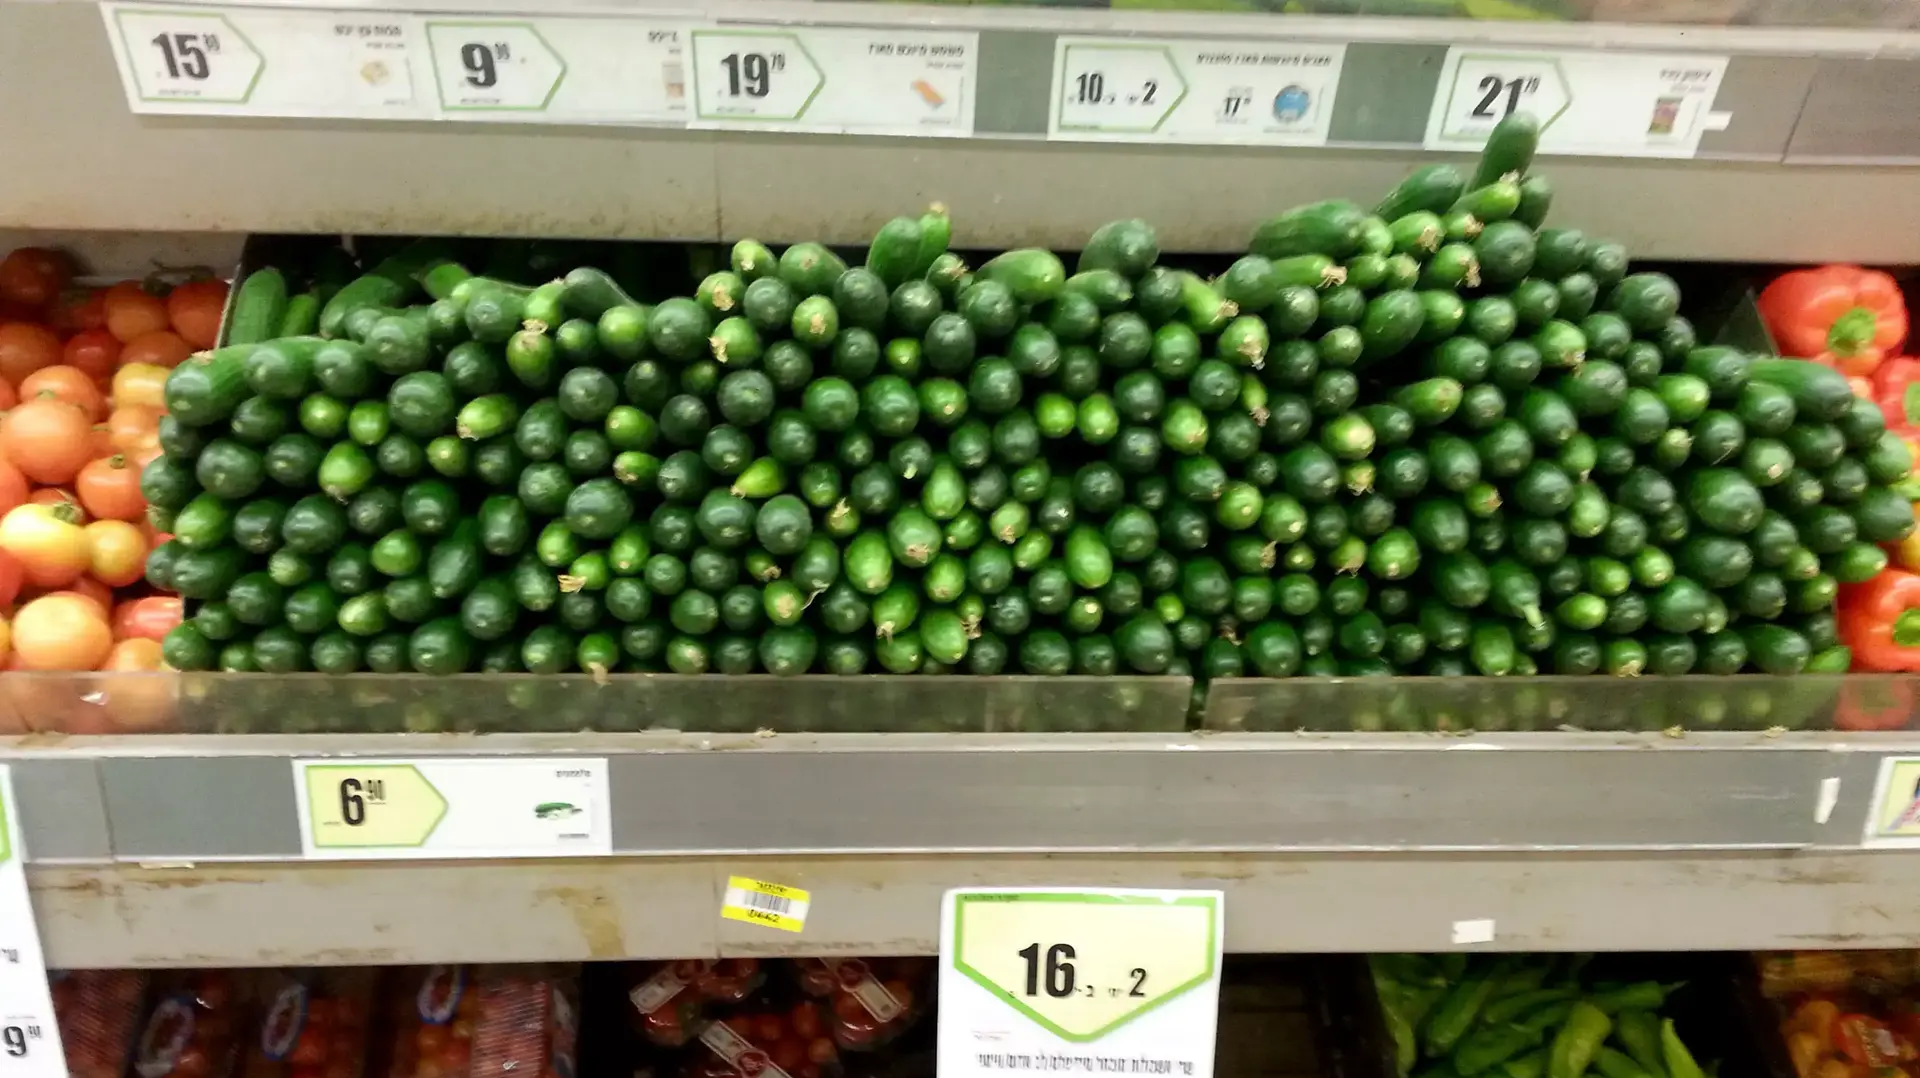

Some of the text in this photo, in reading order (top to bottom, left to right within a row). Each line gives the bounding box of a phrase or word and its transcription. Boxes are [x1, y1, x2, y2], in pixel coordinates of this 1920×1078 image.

[1076, 73, 1103, 103] 10
[1142, 80, 1158, 104] 2
[1018, 942, 1076, 998] 16
[1129, 967, 1148, 997] 2
